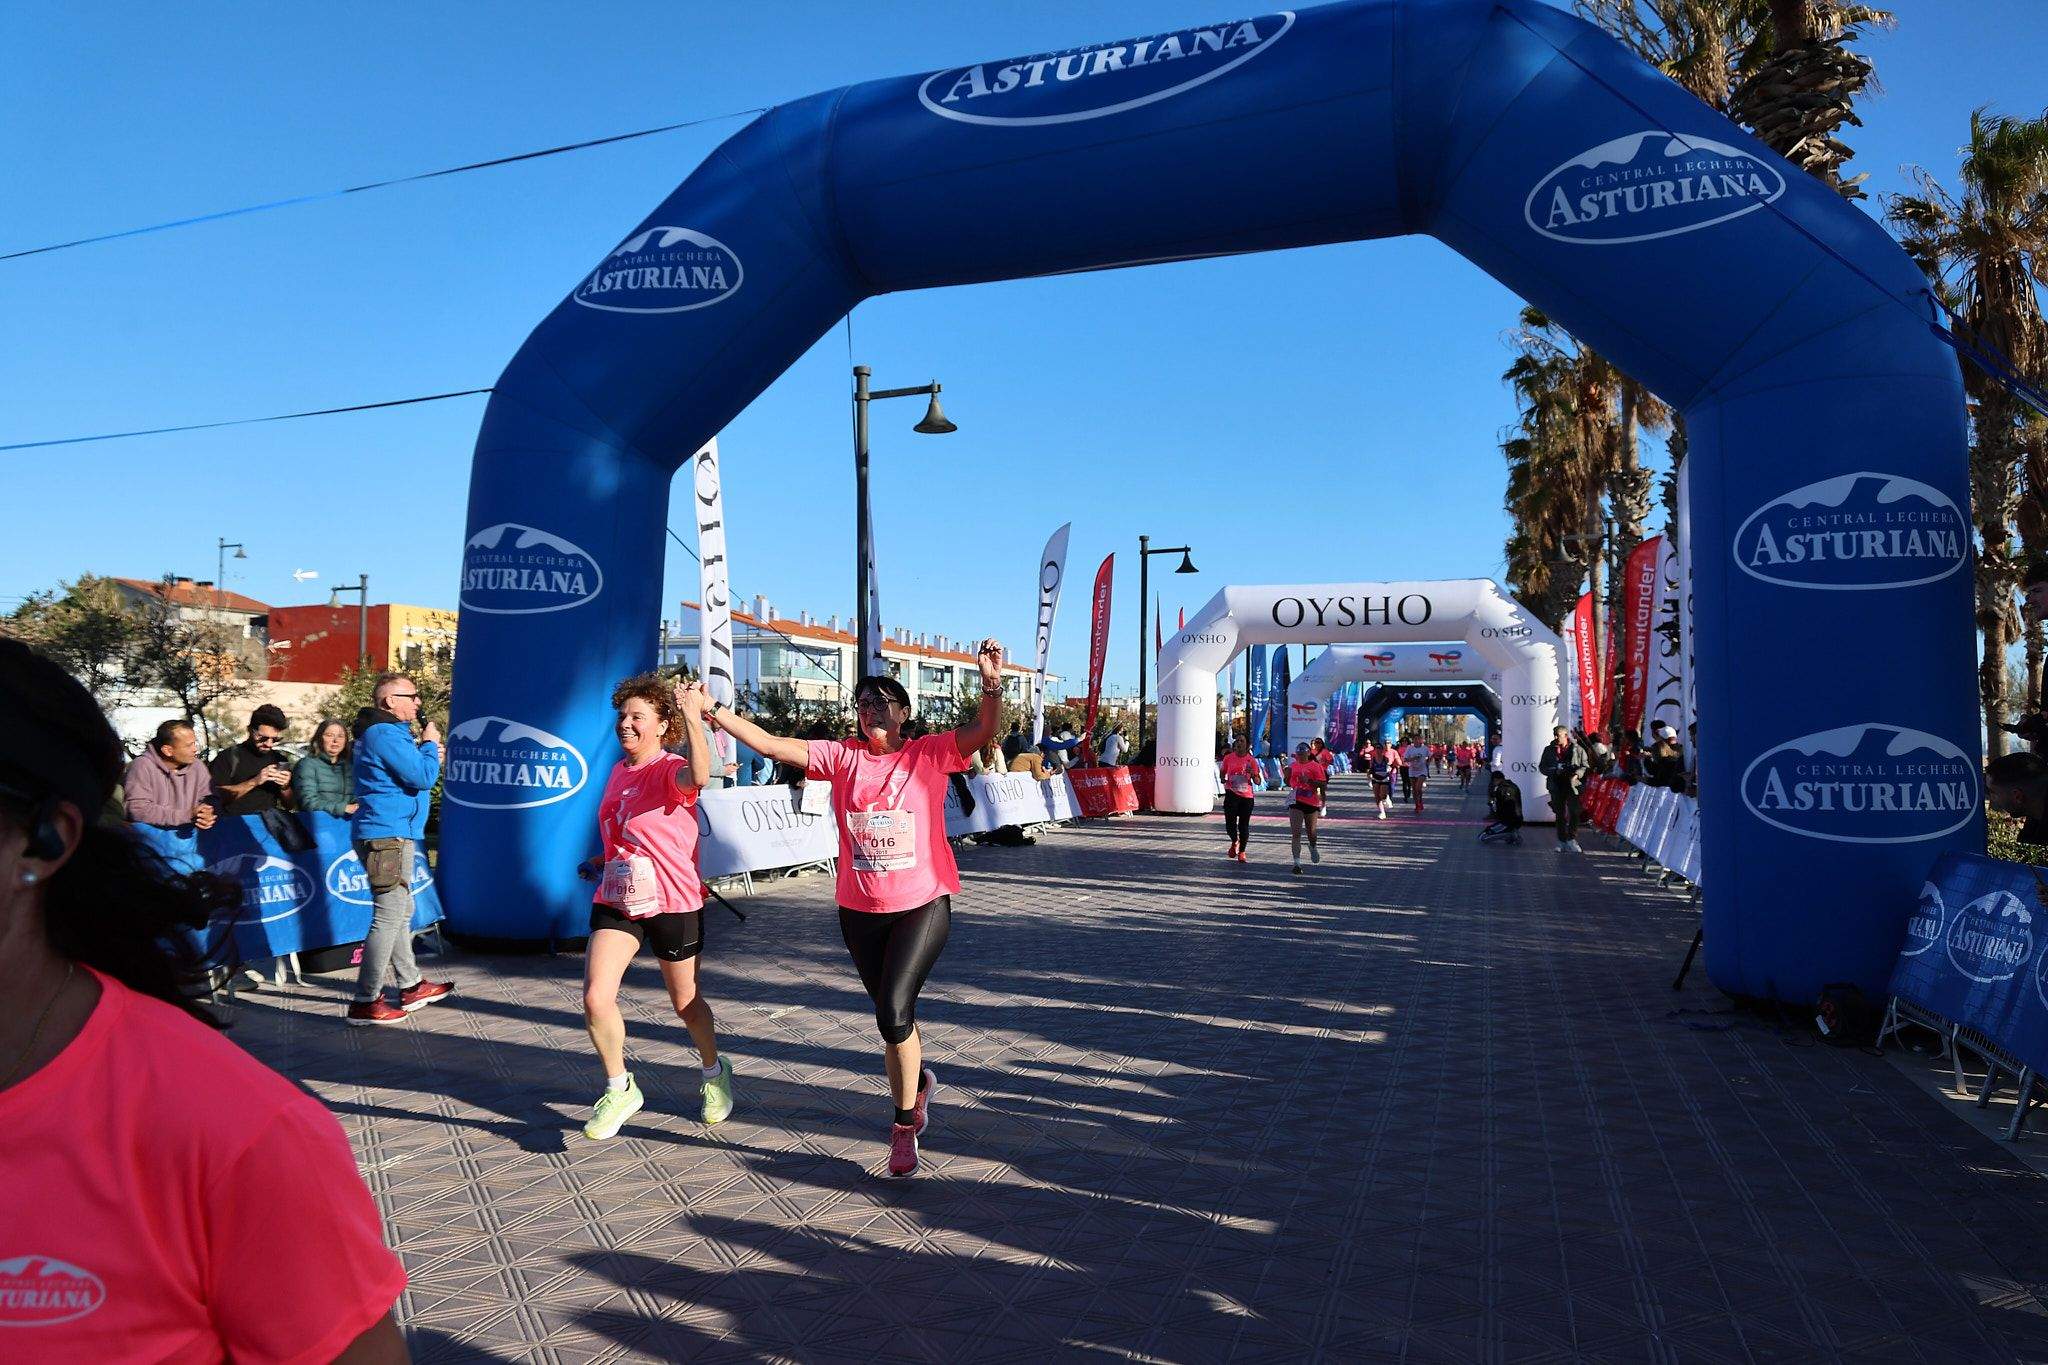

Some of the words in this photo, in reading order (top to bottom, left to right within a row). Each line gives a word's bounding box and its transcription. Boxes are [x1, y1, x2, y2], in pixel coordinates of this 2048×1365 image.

[941, 22, 1262, 103] ASTURIANA
[1581, 165, 1666, 189] CENTRAL
[1674, 159, 1755, 173] LECHERA
[1545, 173, 1771, 229] ASTURIANA
[661, 251, 722, 262] LECHERA
[579, 265, 729, 297] ASTURIANA
[1787, 512, 1878, 530] CENTRAL
[1885, 511, 1954, 525] LECHERA
[1750, 523, 1961, 567] ASTURIANA
[519, 554, 584, 569] LECHERA
[1272, 593, 1433, 628] OYSHO
[1181, 634, 1227, 645] OYSHO
[1480, 627, 1533, 639] OYSHO
[1579, 615, 1594, 687] Santander
[1161, 694, 1202, 706] OYSHO
[1398, 692, 1468, 700] VOLVO
[1510, 694, 1560, 706] OYSHO
[503, 750, 568, 762] LECHERA
[1159, 756, 1200, 768] OYSHO
[1511, 761, 1538, 773] OYS
[1796, 764, 1887, 777] CENTRAL
[1894, 763, 1965, 776] LECHERA
[984, 778, 1024, 805] OYSHO
[1757, 766, 1972, 812] ASTURIANA
[871, 837, 895, 848] 016
